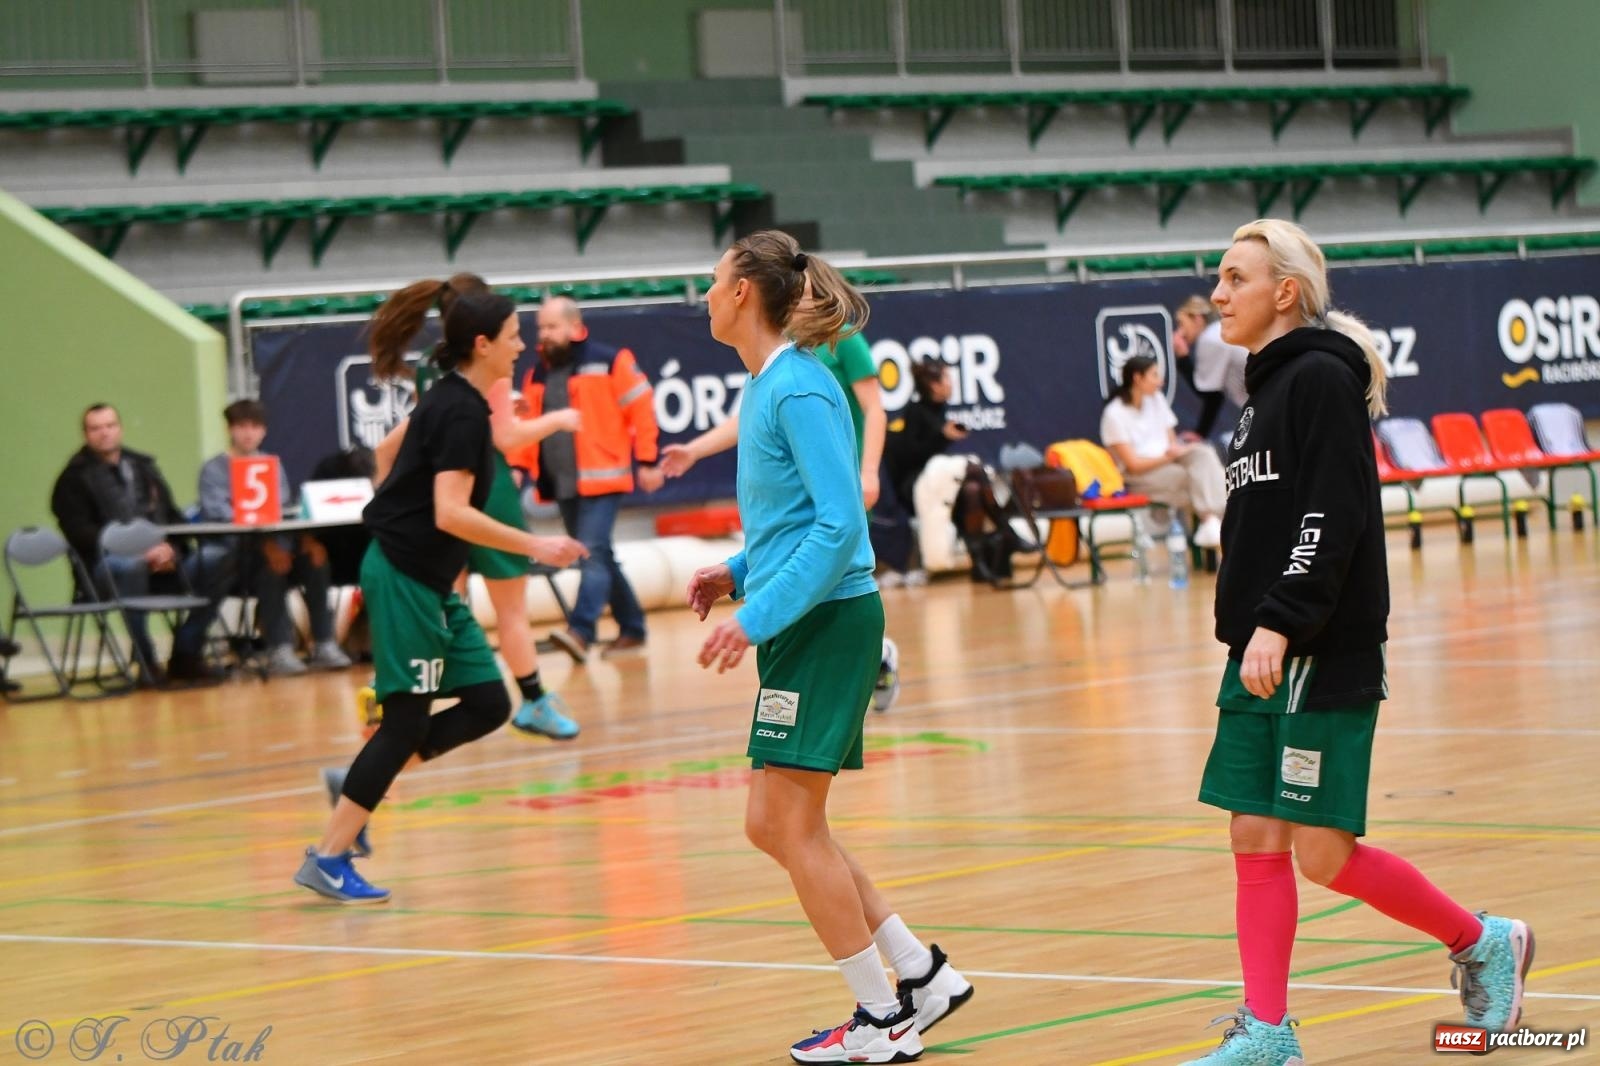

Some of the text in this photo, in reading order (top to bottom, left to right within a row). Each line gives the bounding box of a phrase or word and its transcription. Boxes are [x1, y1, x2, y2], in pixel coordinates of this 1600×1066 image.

[1497, 295, 1600, 364] OSiR
[239, 463, 269, 511] 5
[1282, 512, 1325, 576] LEWA
[409, 657, 445, 694] 30
[756, 729, 788, 739] COLO
